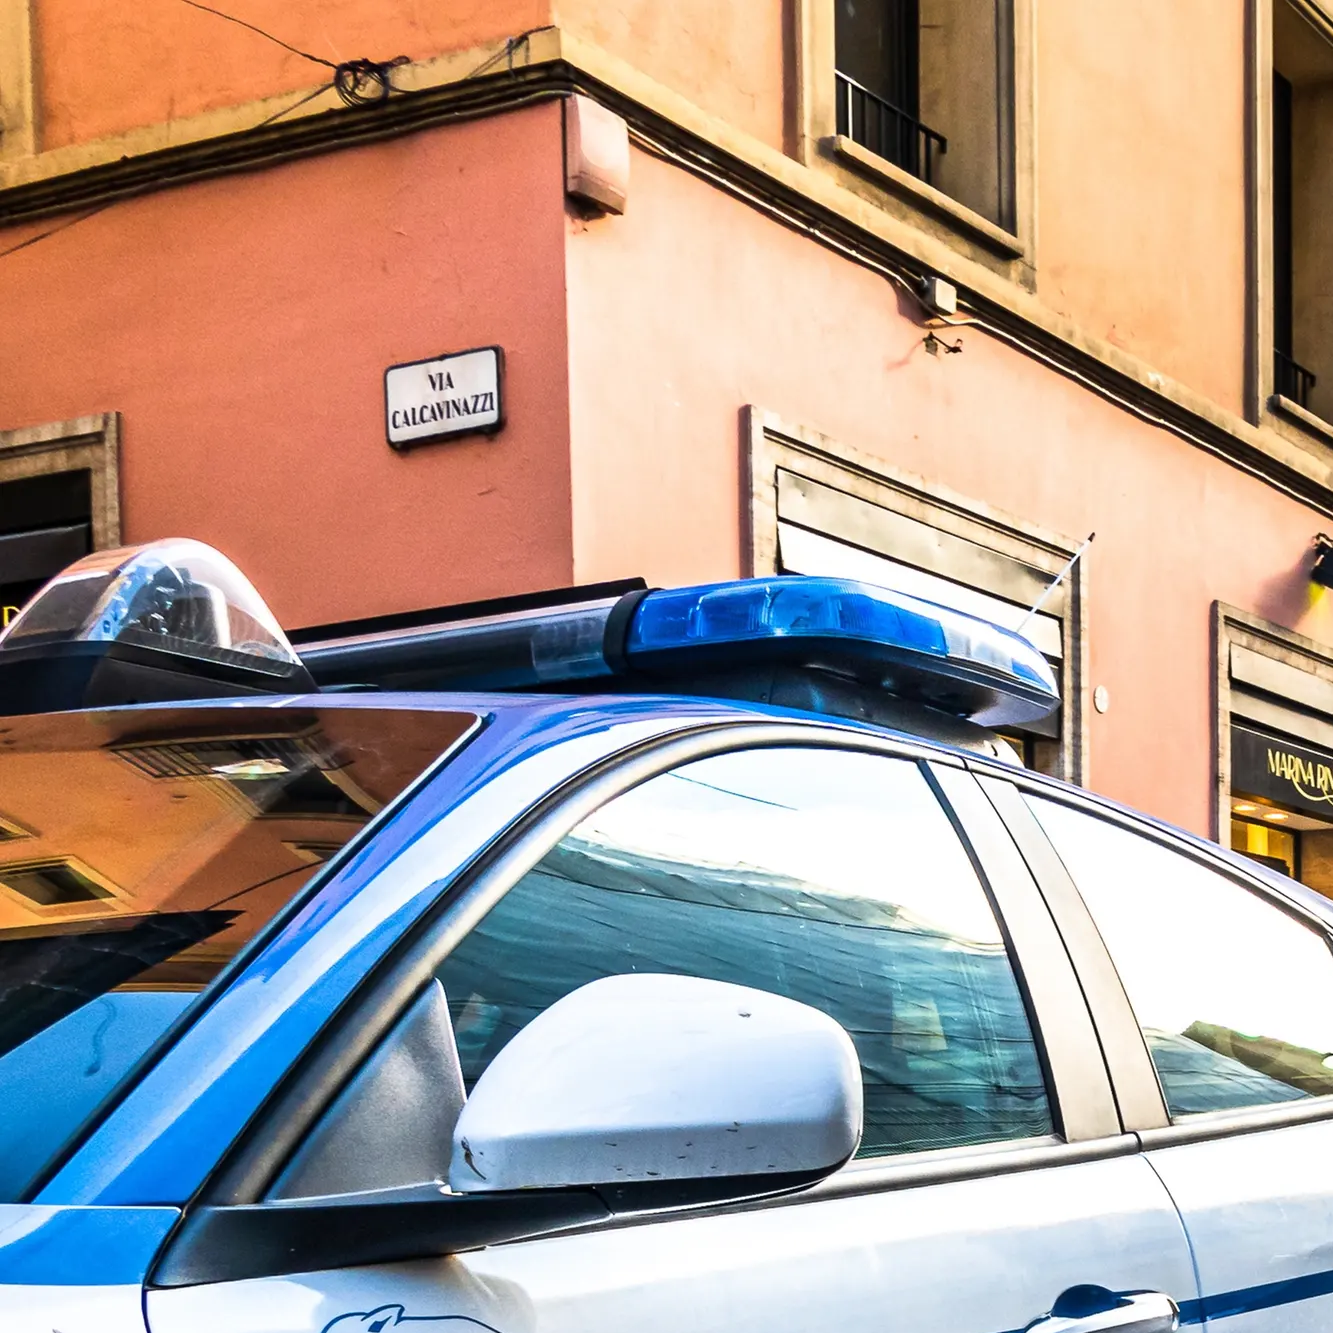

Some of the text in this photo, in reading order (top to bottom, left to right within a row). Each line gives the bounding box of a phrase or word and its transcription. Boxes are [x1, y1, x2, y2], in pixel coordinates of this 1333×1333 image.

[428, 371, 455, 392] VIA
[391, 391, 495, 429] CALCAVINAZZI
[1267, 748, 1317, 800] MARINA
